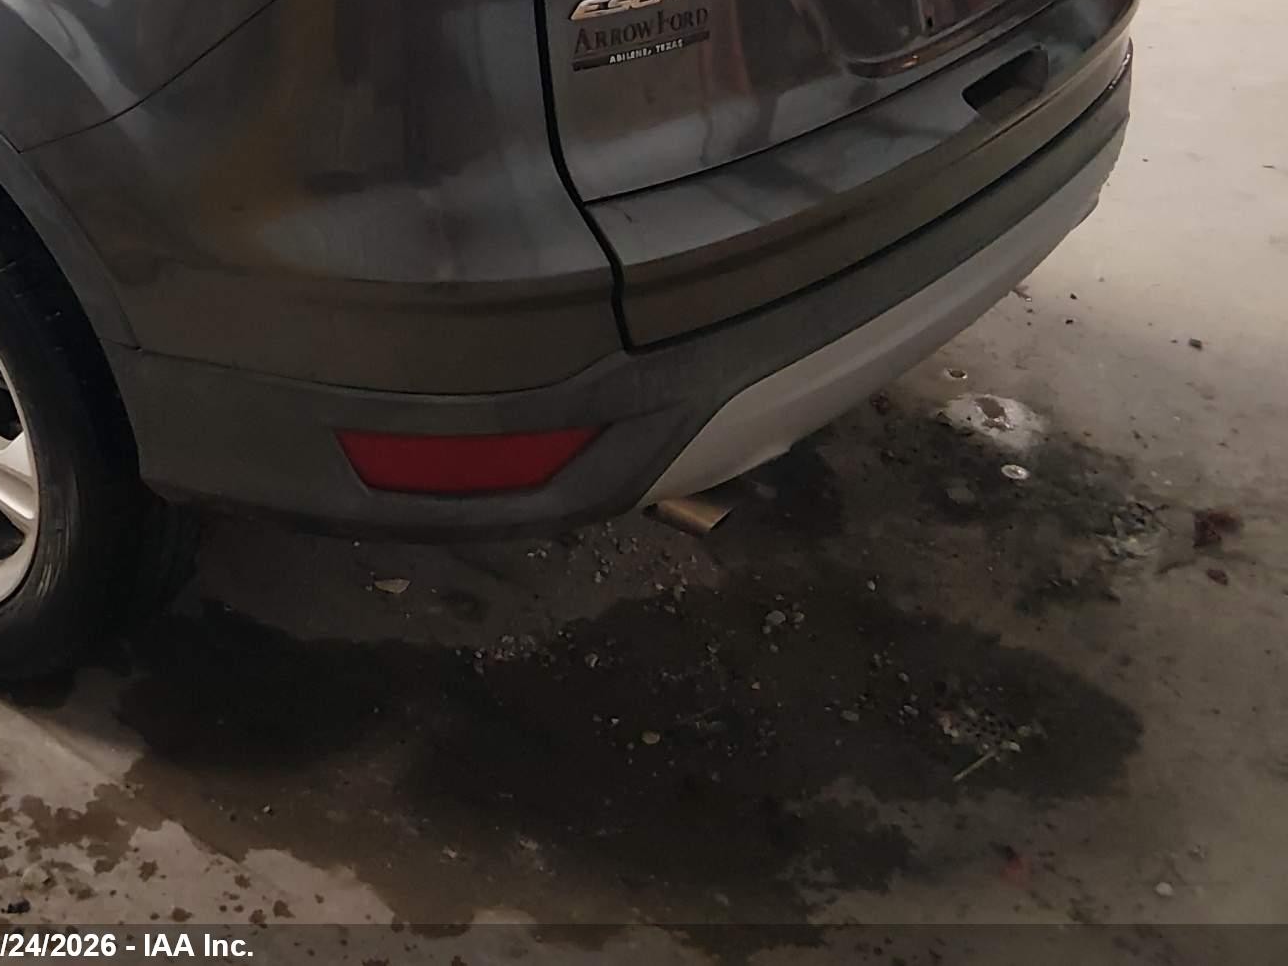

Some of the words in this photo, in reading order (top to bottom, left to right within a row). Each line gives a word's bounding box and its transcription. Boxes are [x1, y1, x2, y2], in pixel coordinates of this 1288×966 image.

[574, 20, 652, 55] ARROW
[657, 7, 709, 34] FORD
[655, 39, 684, 54] TEXAS
